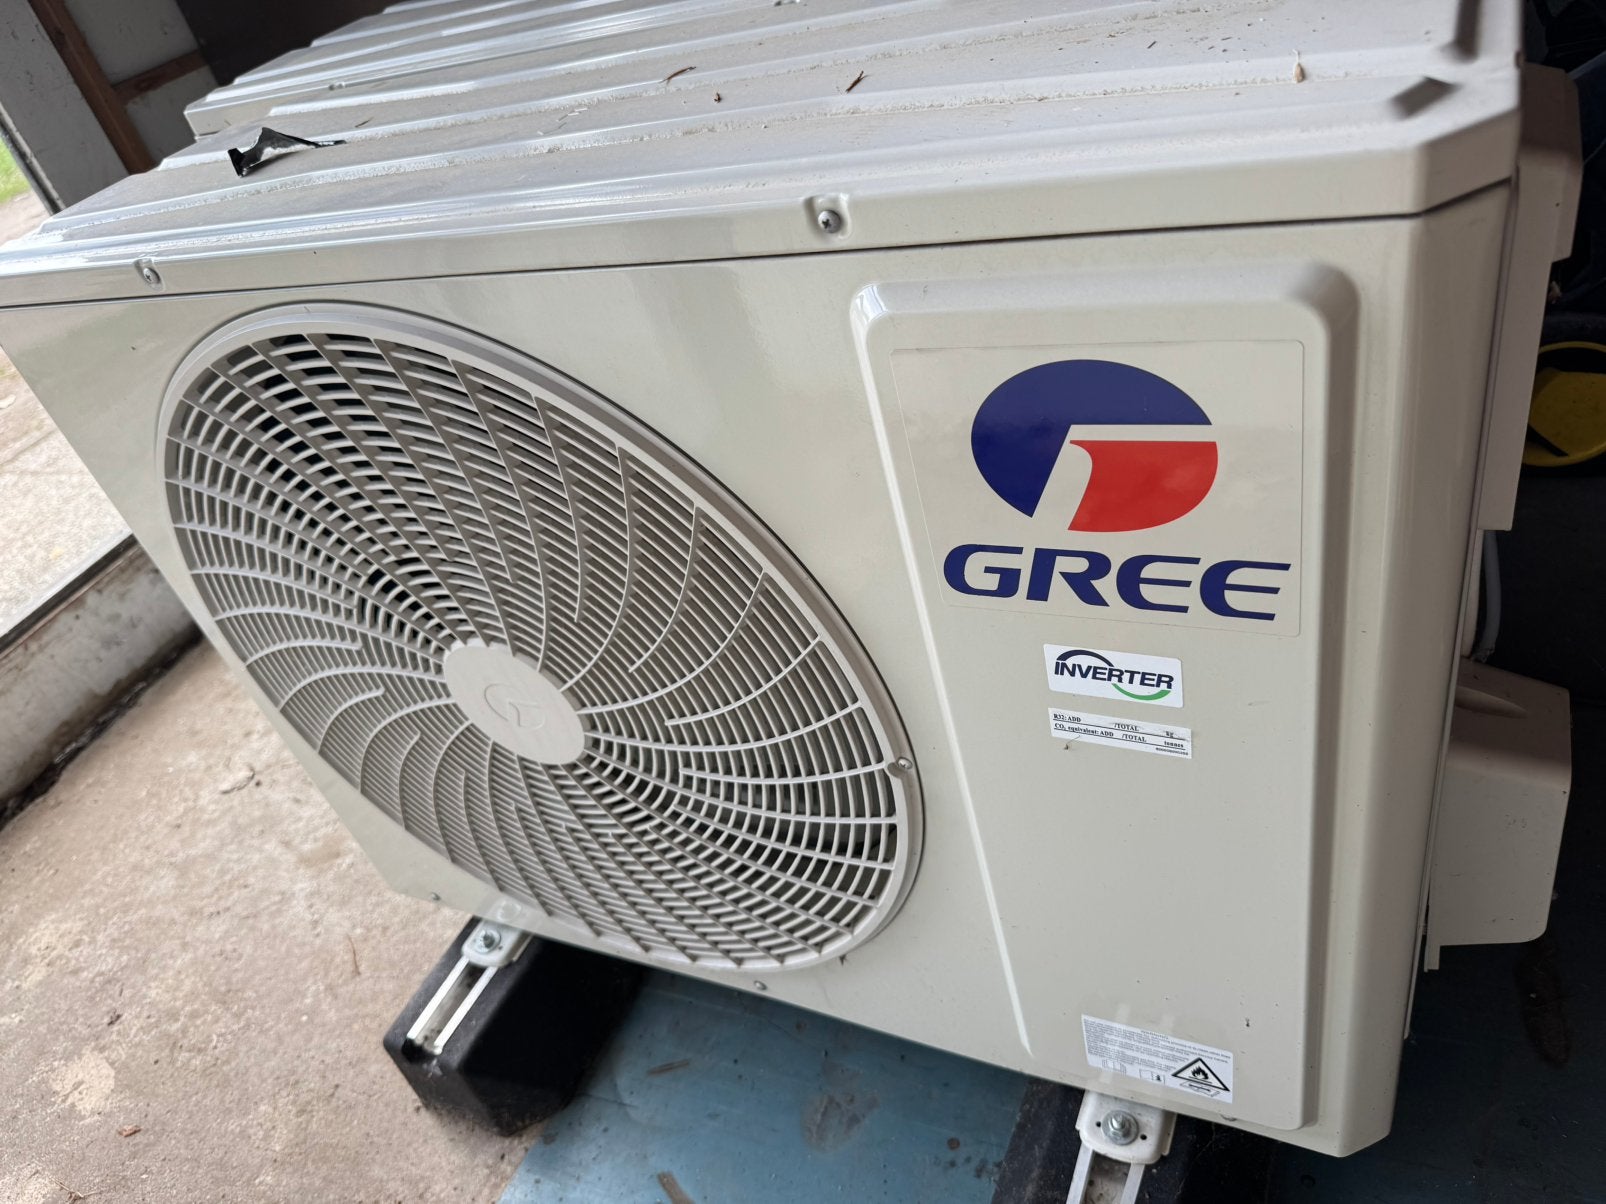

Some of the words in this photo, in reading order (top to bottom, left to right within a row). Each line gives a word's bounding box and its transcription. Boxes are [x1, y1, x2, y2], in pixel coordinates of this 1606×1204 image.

[943, 543, 1292, 621] GREE
[1054, 661, 1174, 690] INVERTER
[1067, 715, 1082, 723] ADD
[1114, 723, 1140, 732] /TOTAL
[1100, 730, 1114, 738] ADD
[1121, 734, 1147, 743] /TOTAL
